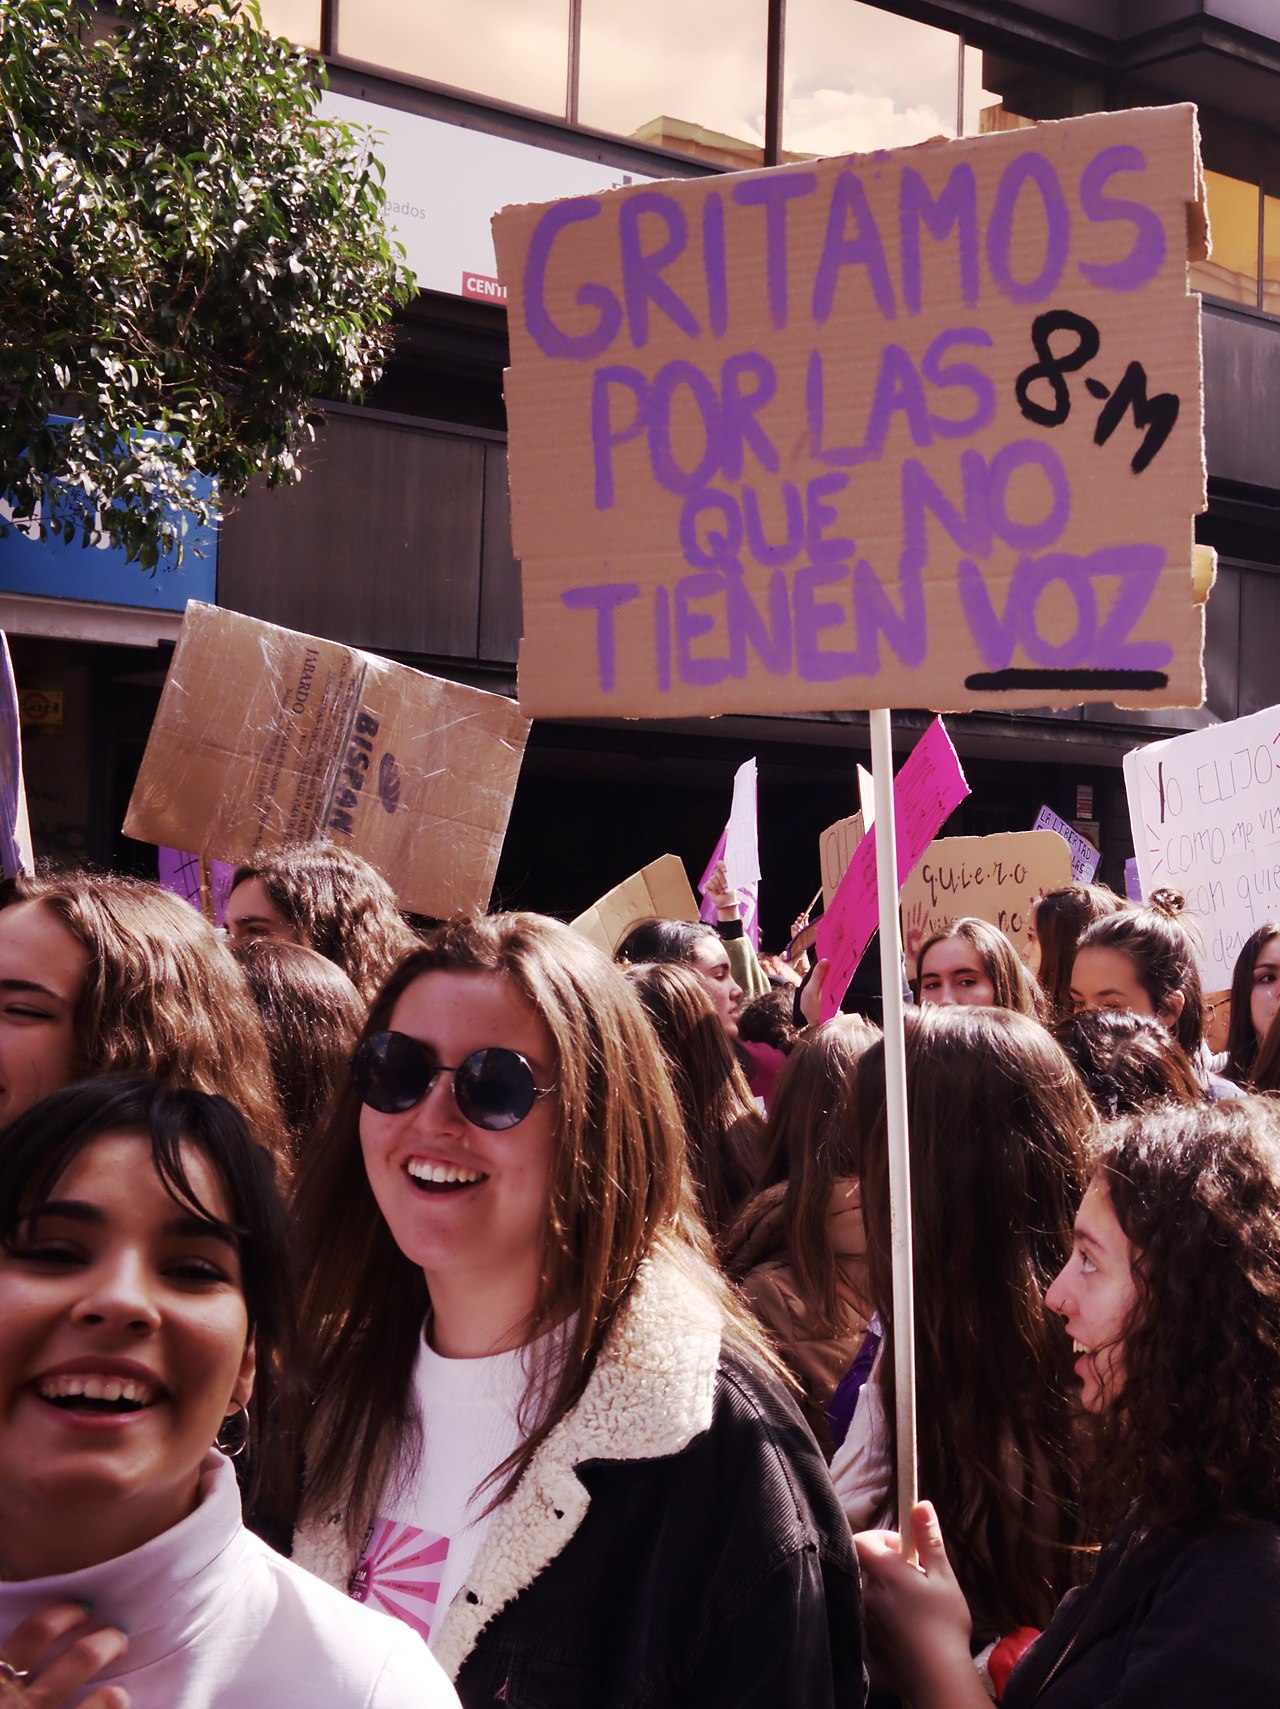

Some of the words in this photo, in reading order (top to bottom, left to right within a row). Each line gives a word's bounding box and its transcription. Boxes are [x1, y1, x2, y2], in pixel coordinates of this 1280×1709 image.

[523, 144, 1168, 360] GRITAMOS
[591, 351, 781, 511] POR
[807, 327, 998, 467] LAS
[678, 472, 857, 578] QUE
[899, 439, 1072, 570] NO
[560, 560, 928, 694] TIENEN
[957, 543, 1175, 672] VOZ
[329, 711, 380, 836] BISPAN
[1039, 809, 1052, 826] LA
[1052, 817, 1093, 861] LIBERTAD
[1196, 744, 1273, 805] ELIJO
